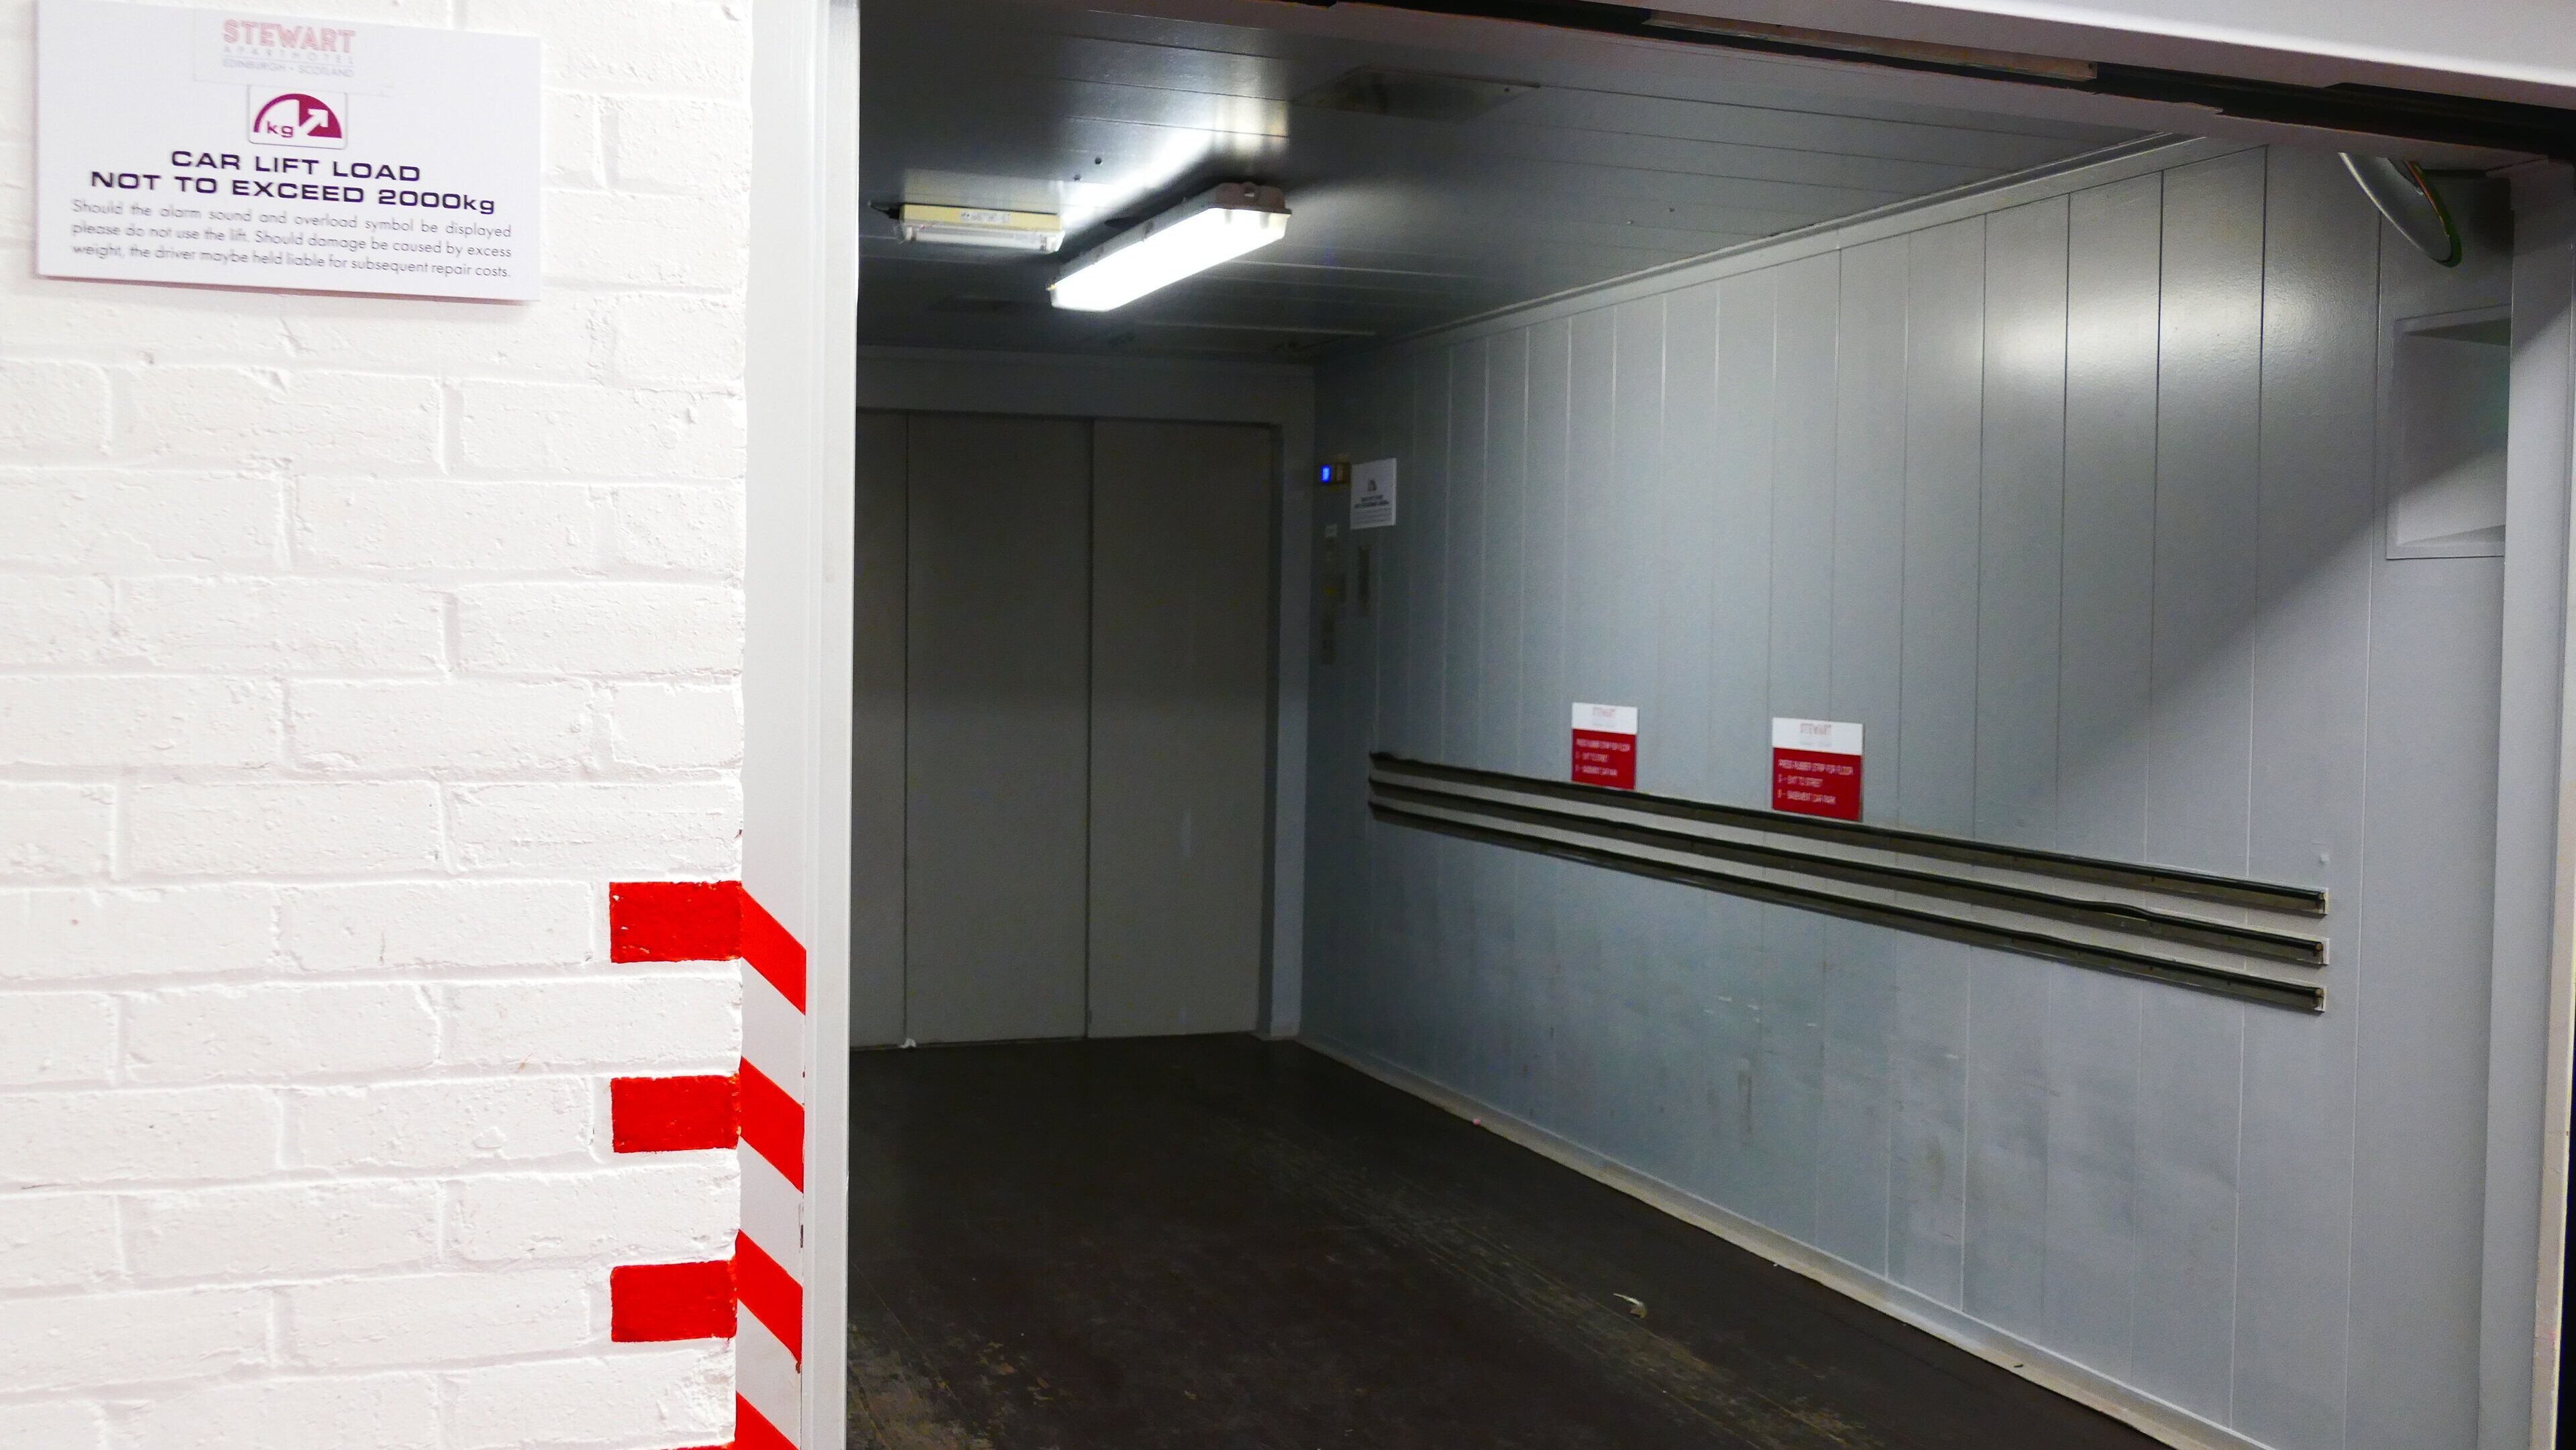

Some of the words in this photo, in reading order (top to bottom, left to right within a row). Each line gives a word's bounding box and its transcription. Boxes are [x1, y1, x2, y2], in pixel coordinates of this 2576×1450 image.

[223, 19, 356, 54] STEWART
[267, 121, 293, 138] kg
[171, 150, 240, 170] CAR
[255, 156, 319, 175] LIFT
[333, 160, 421, 182] LOAD
[91, 170, 161, 190] NOT
[174, 174, 217, 194] TO
[232, 180, 364, 204] EXCEED
[378, 189, 495, 215] 2000kg
[72, 199, 123, 215] Should
[130, 201, 152, 217] the
[160, 204, 202, 218] alarm
[208, 207, 252, 222] sound
[259, 210, 286, 224] and
[294, 213, 357, 228] overload
[365, 217, 413, 232] symbol
[421, 219, 439, 233] be
[445, 220, 511, 240] displayed
[72, 220, 121, 237] please
[125, 221, 144, 237] do
[149, 225, 172, 238] not
[176, 229, 199, 240] use
[204, 227, 225, 241] the
[229, 227, 250, 243] lift.
[254, 229, 303, 246] Should
[308, 233, 366, 252] damage
[371, 236, 388, 250] be
[392, 238, 441, 254] caused
[446, 241, 462, 258] by
[467, 246, 512, 258] excess
[72, 244, 125, 260] weight,
[130, 244, 150, 258] the
[154, 245, 196, 261] driver
[199, 248, 248, 266] maybe
[252, 250, 282, 265] held
[286, 252, 325, 268] liable
[329, 254, 347, 268] for
[352, 256, 428, 274] subsequent
[431, 262, 472, 277] repair
[475, 266, 511, 278] costs.
